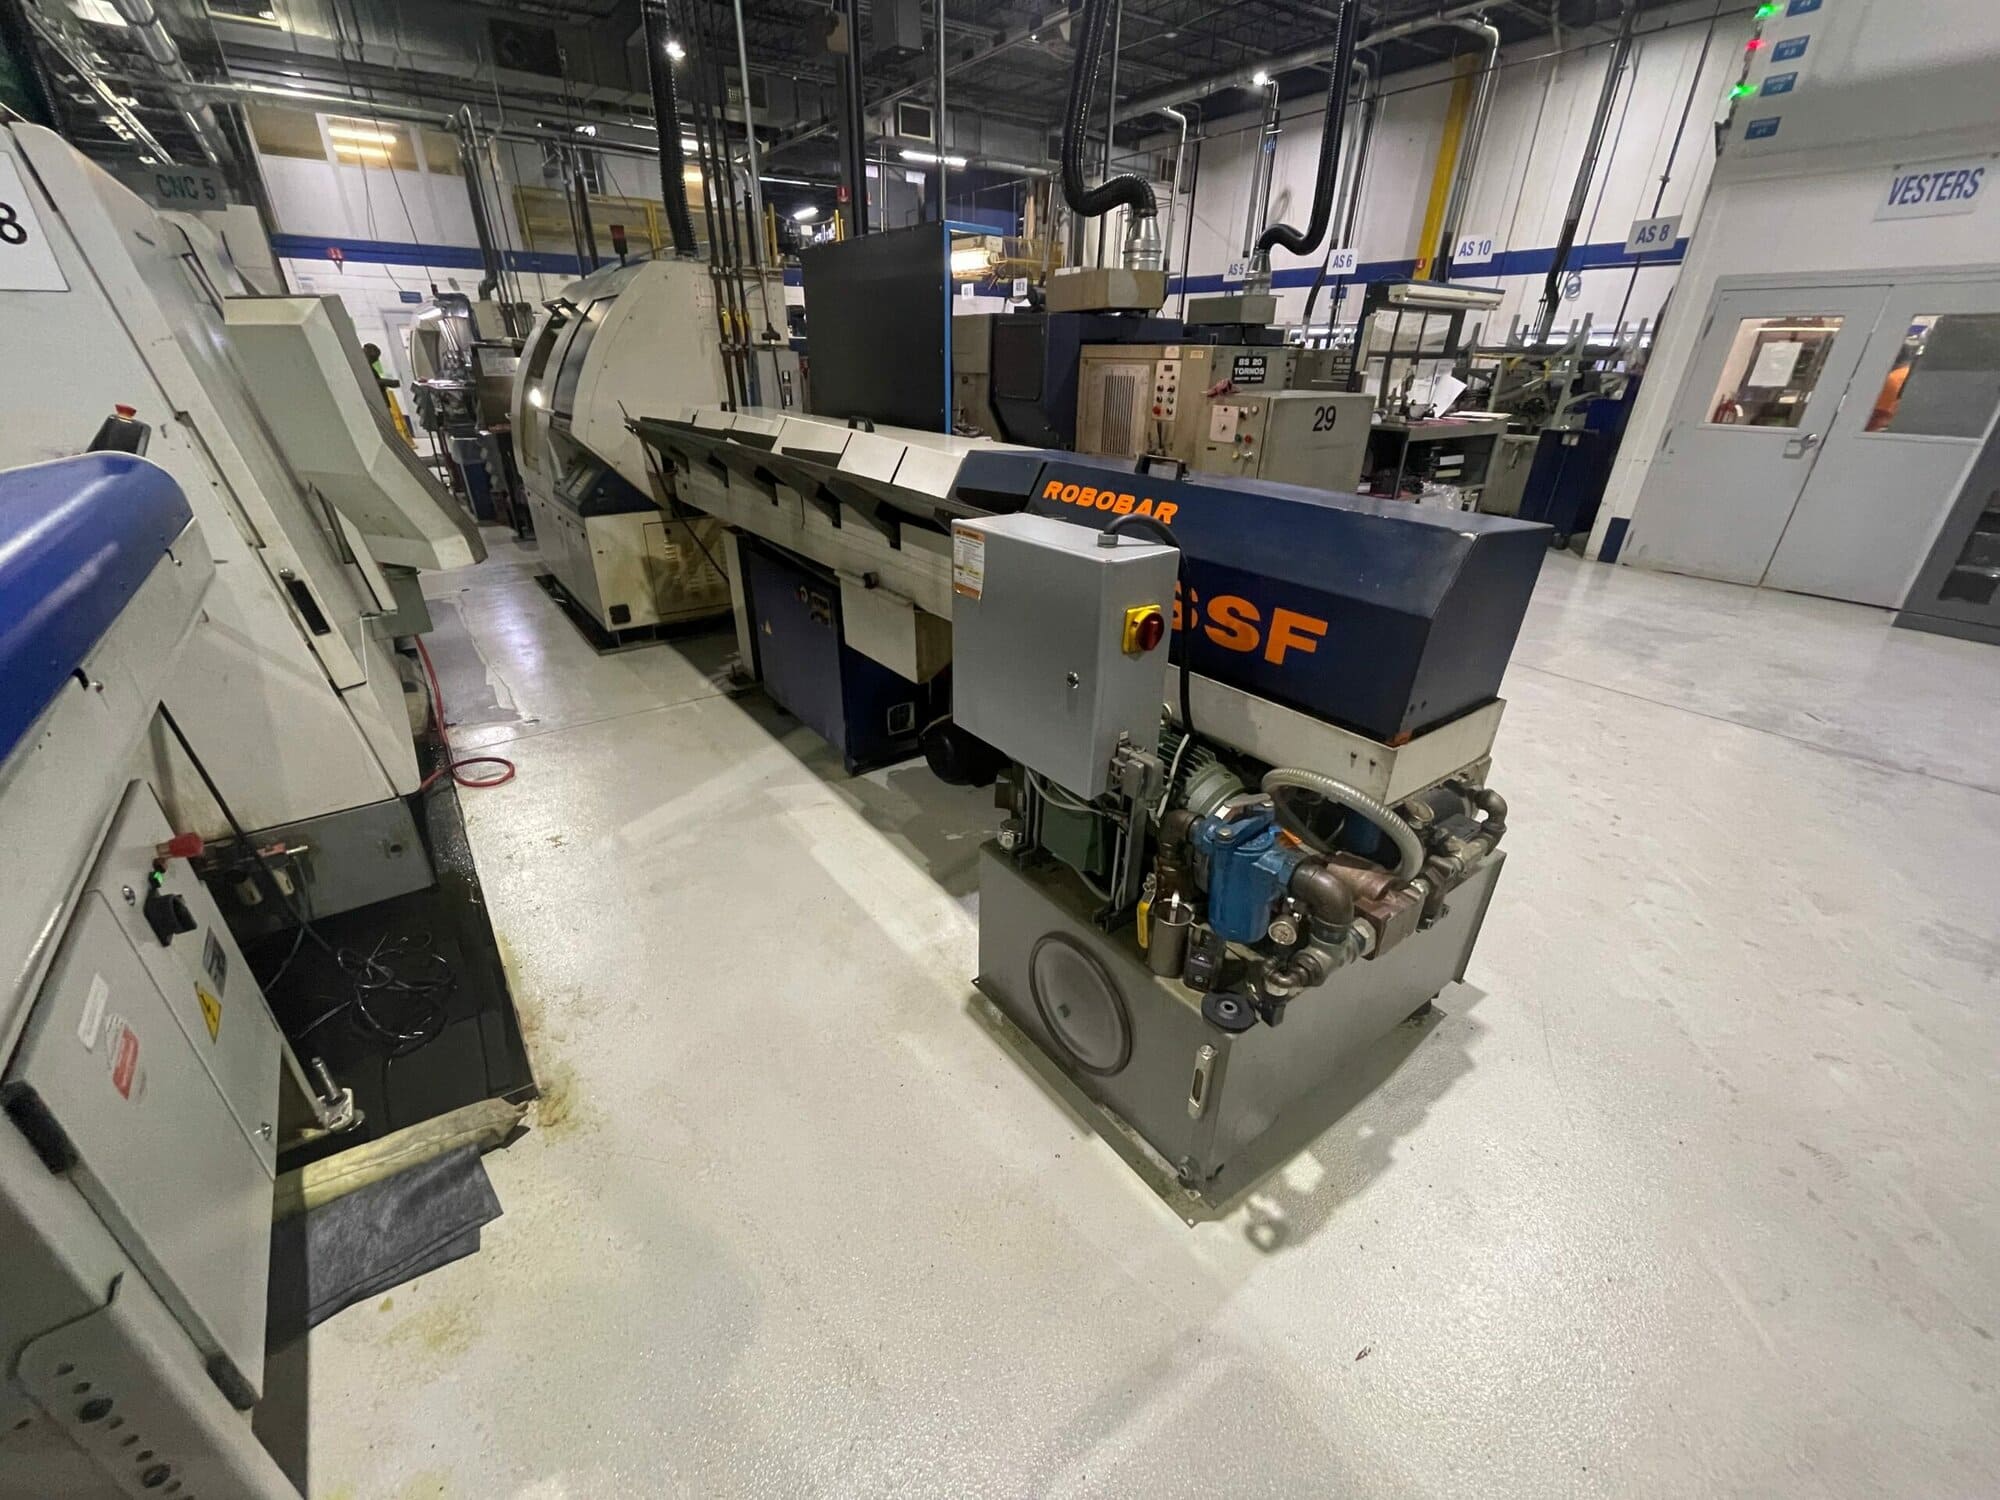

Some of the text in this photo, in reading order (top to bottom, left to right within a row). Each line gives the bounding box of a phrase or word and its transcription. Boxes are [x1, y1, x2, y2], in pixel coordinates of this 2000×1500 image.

[156, 174, 216, 201] CNC 5
[1887, 167, 1985, 206] VESTERS
[1635, 224, 1670, 245] AS 8
[1458, 240, 1492, 257] AS 10
[1228, 264, 1239, 276] AS
[1333, 254, 1353, 268] AS 6
[1312, 405, 1337, 432] 29
[1043, 480, 1178, 525] ROBOBAR
